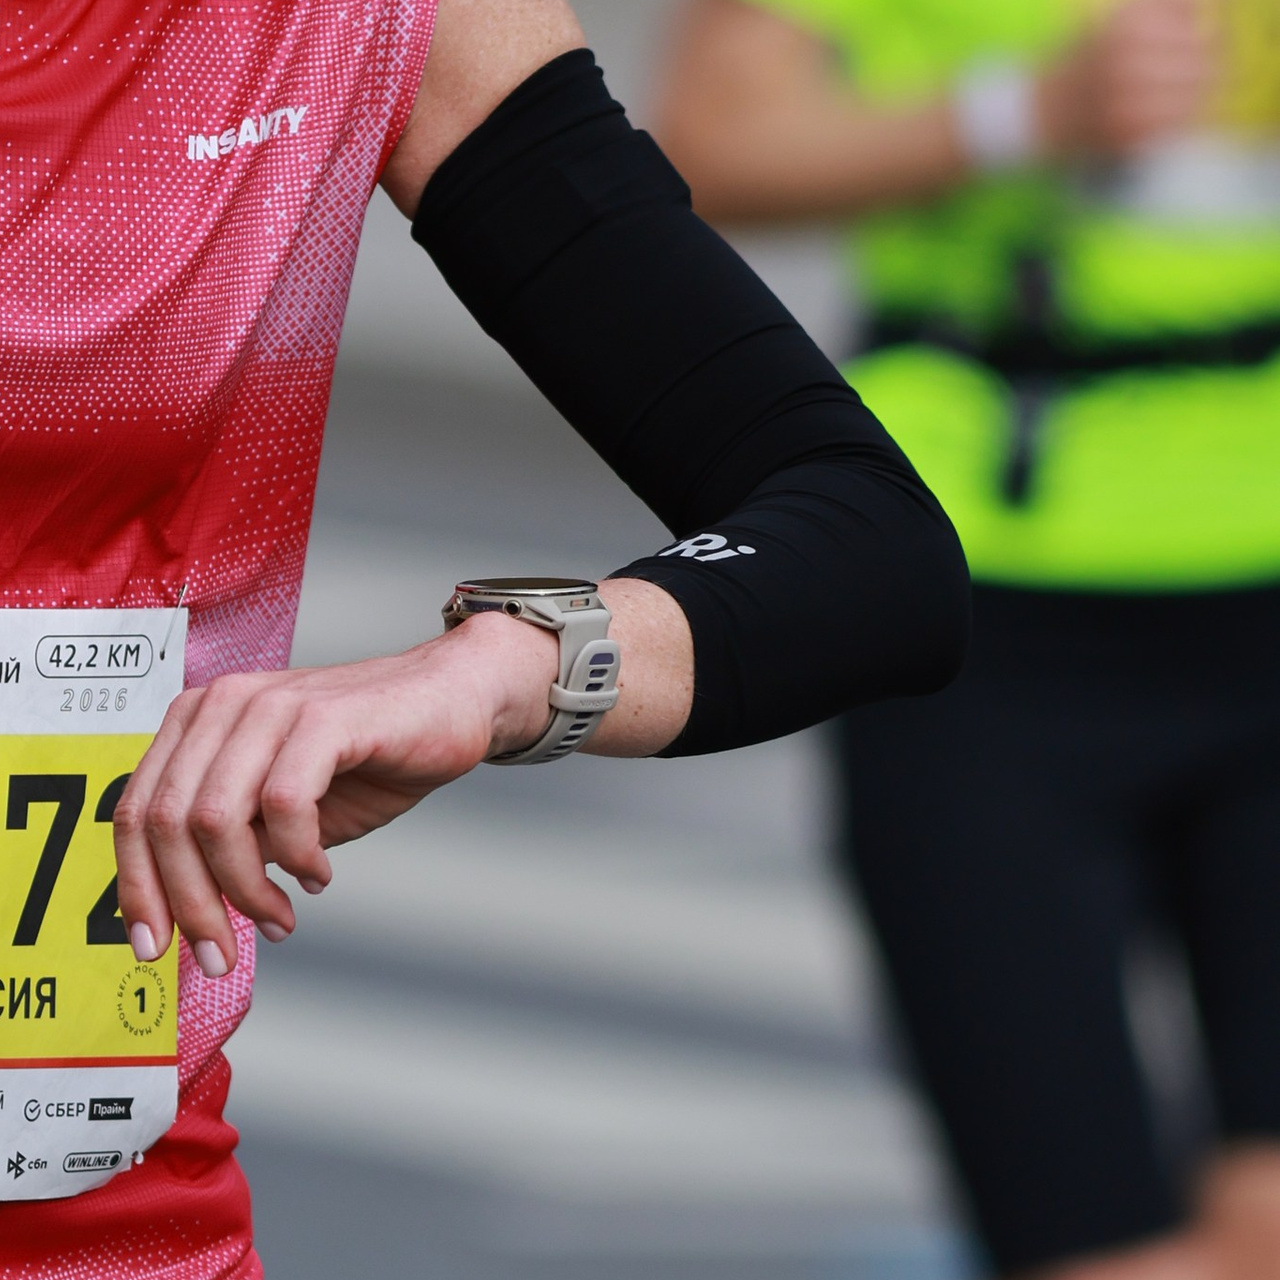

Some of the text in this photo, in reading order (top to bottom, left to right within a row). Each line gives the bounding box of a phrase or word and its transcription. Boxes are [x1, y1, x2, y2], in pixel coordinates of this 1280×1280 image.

[187, 105, 309, 160] INSANTY
[658, 533, 756, 562] Ri
[49, 643, 141, 672] 42,2 КМ
[60, 688, 128, 712] 2026
[134, 987, 145, 1013] 1
[45, 1102, 125, 1118] СБЕР Прайм
[68, 1155, 110, 1168] WINLINE
